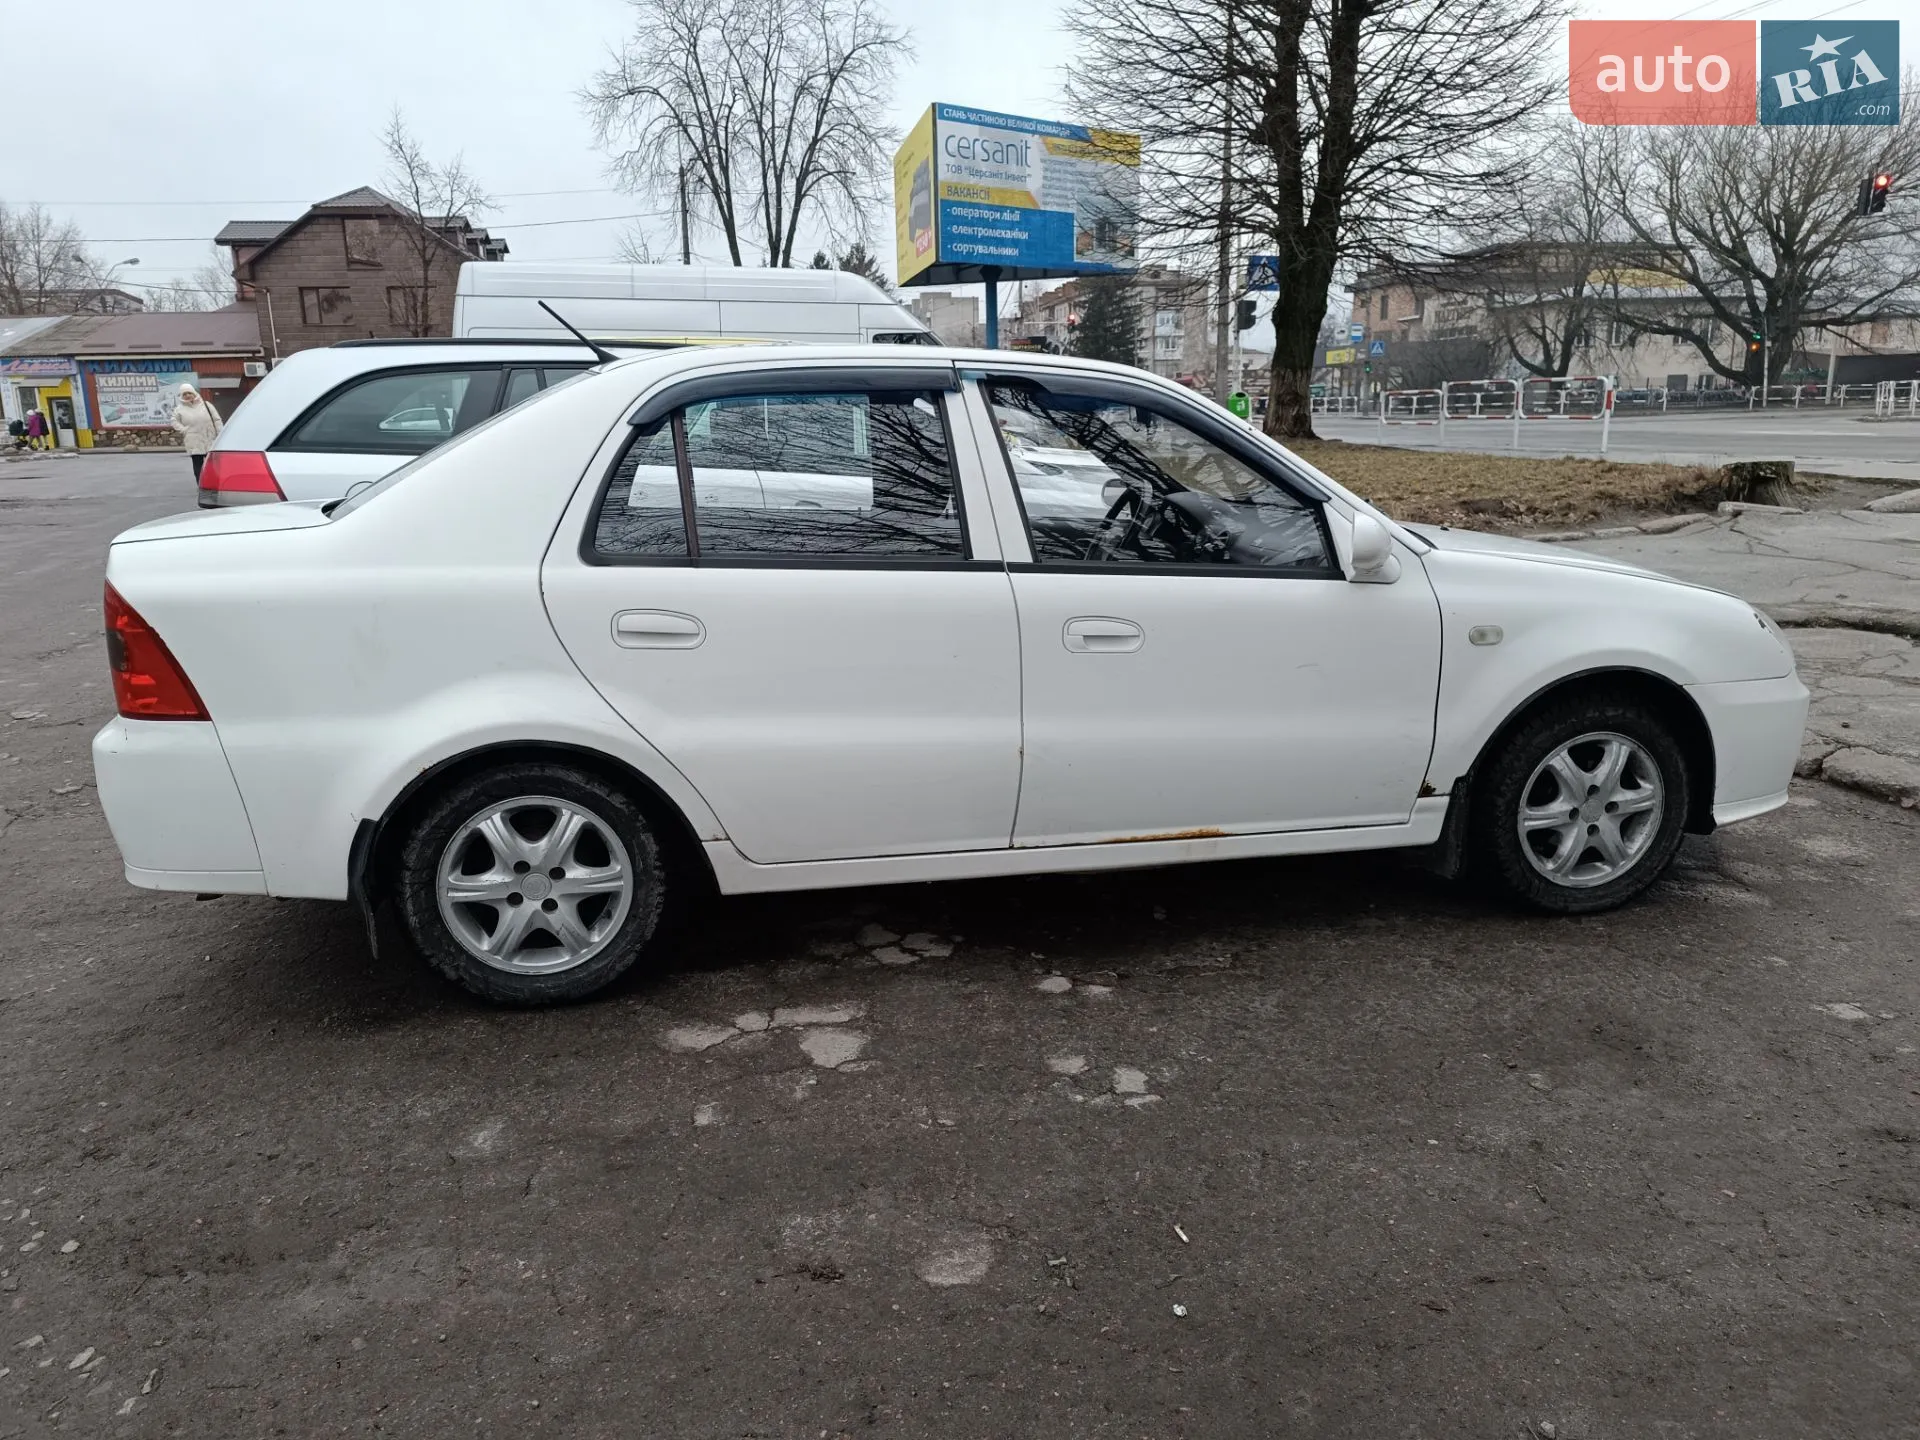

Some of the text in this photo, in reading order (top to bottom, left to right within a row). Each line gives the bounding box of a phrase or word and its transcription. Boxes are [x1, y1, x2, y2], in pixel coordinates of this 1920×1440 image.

[943, 107, 967, 119] СТАНЬ
[967, 112, 1006, 125] ЧАСТИНОЮ
[1007, 117, 1036, 130] ВЕЛИКОЇ
[945, 134, 1032, 168] cersanit
[945, 163, 963, 174] ТОВ
[946, 185, 990, 201] ВАКАНСІЇ
[951, 206, 1000, 222] оператори
[951, 225, 1029, 240] електромеханіки
[952, 242, 1019, 257] сортувальники
[98, 376, 157, 387] КИЛИМИ
